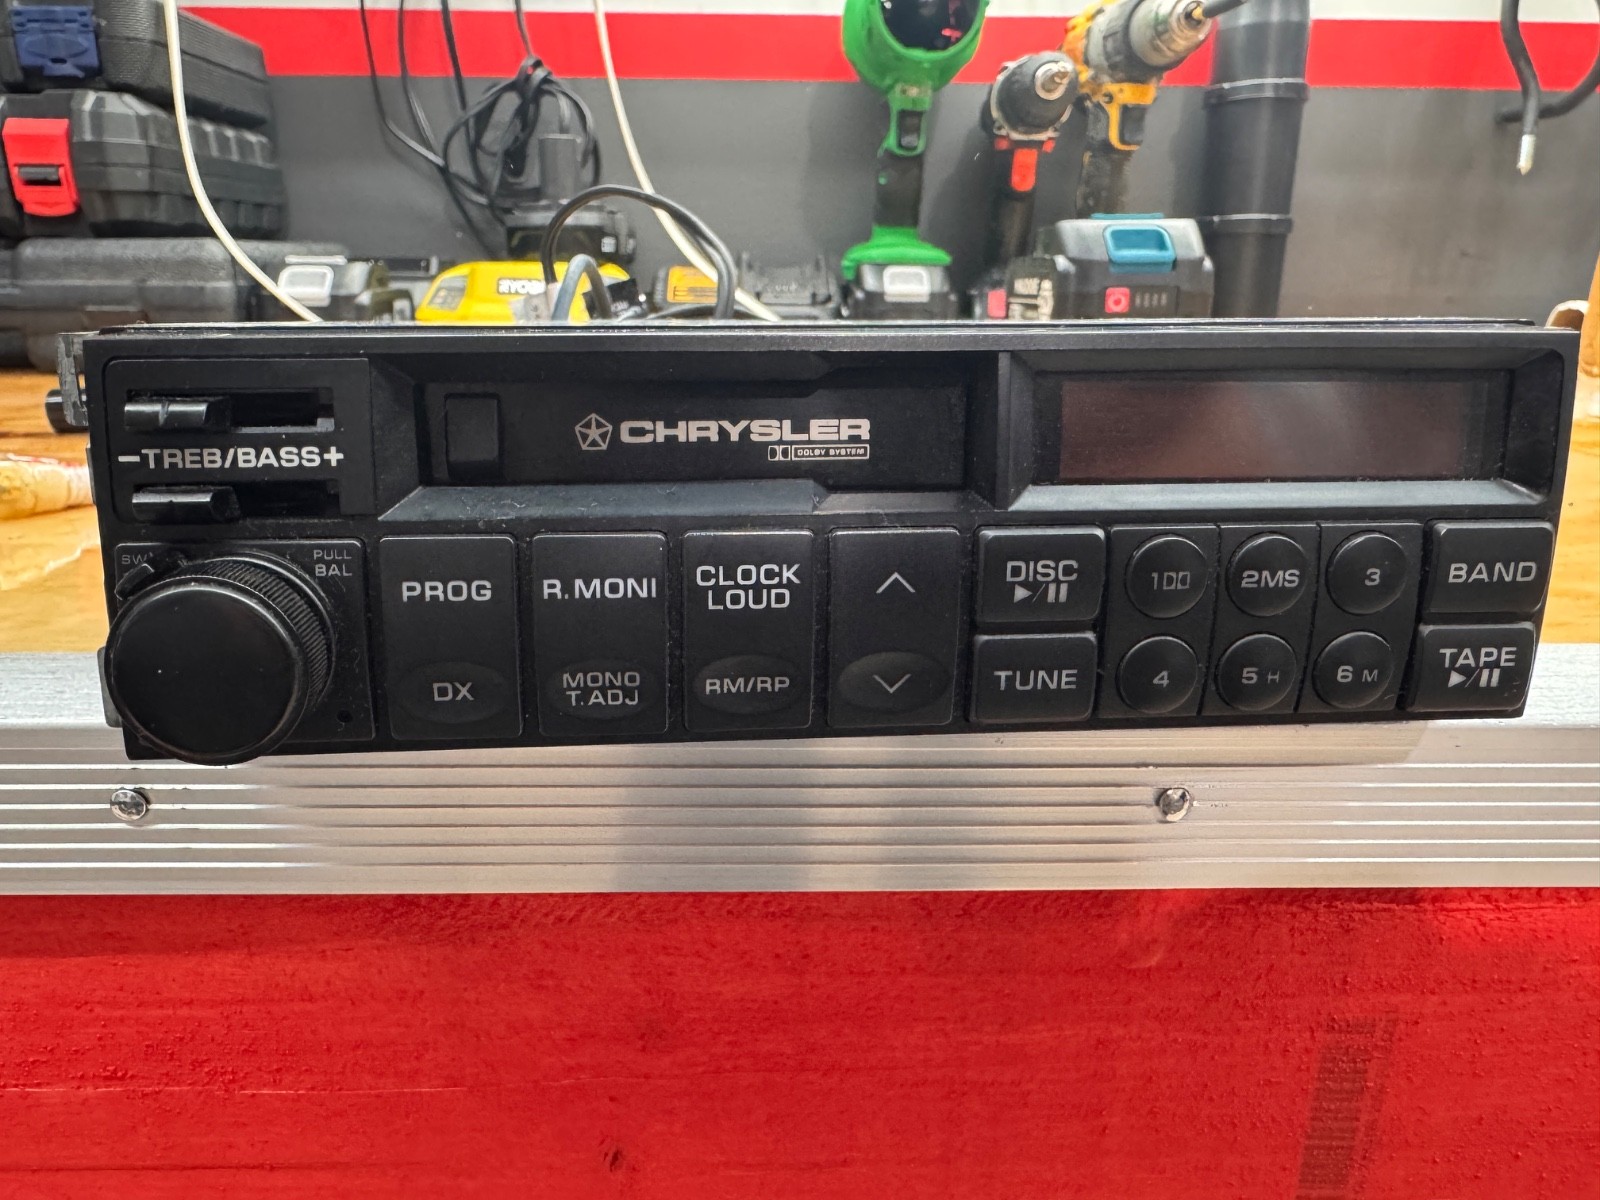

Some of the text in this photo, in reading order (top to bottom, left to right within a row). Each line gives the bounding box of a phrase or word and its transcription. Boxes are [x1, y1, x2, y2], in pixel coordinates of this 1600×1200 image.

[621, 419, 870, 443] CHRYSLER
[797, 448, 826, 456] DOLBY
[828, 447, 866, 456] SYSTEM
[120, 552, 155, 566] SW
[313, 550, 352, 561] PULL
[314, 564, 353, 577] BAL
[696, 564, 801, 587] CLOCK
[1006, 560, 1079, 582] DISC
[1241, 570, 1300, 588] 2MS
[1364, 568, 1381, 586] 3
[1447, 562, 1537, 583] BAND
[401, 581, 492, 602] PROG
[542, 578, 657, 600] R.MONI
[707, 589, 791, 610] LOUD
[1439, 647, 1517, 668] TAPE
[562, 672, 641, 689] MONO
[993, 670, 1078, 691] TUNE
[1152, 671, 1170, 688] 4
[1241, 668, 1259, 685] 5
[1336, 666, 1354, 683] 6
[432, 683, 474, 702] DX
[705, 677, 790, 695] RM/RP
[565, 690, 639, 707] T.ADJ
